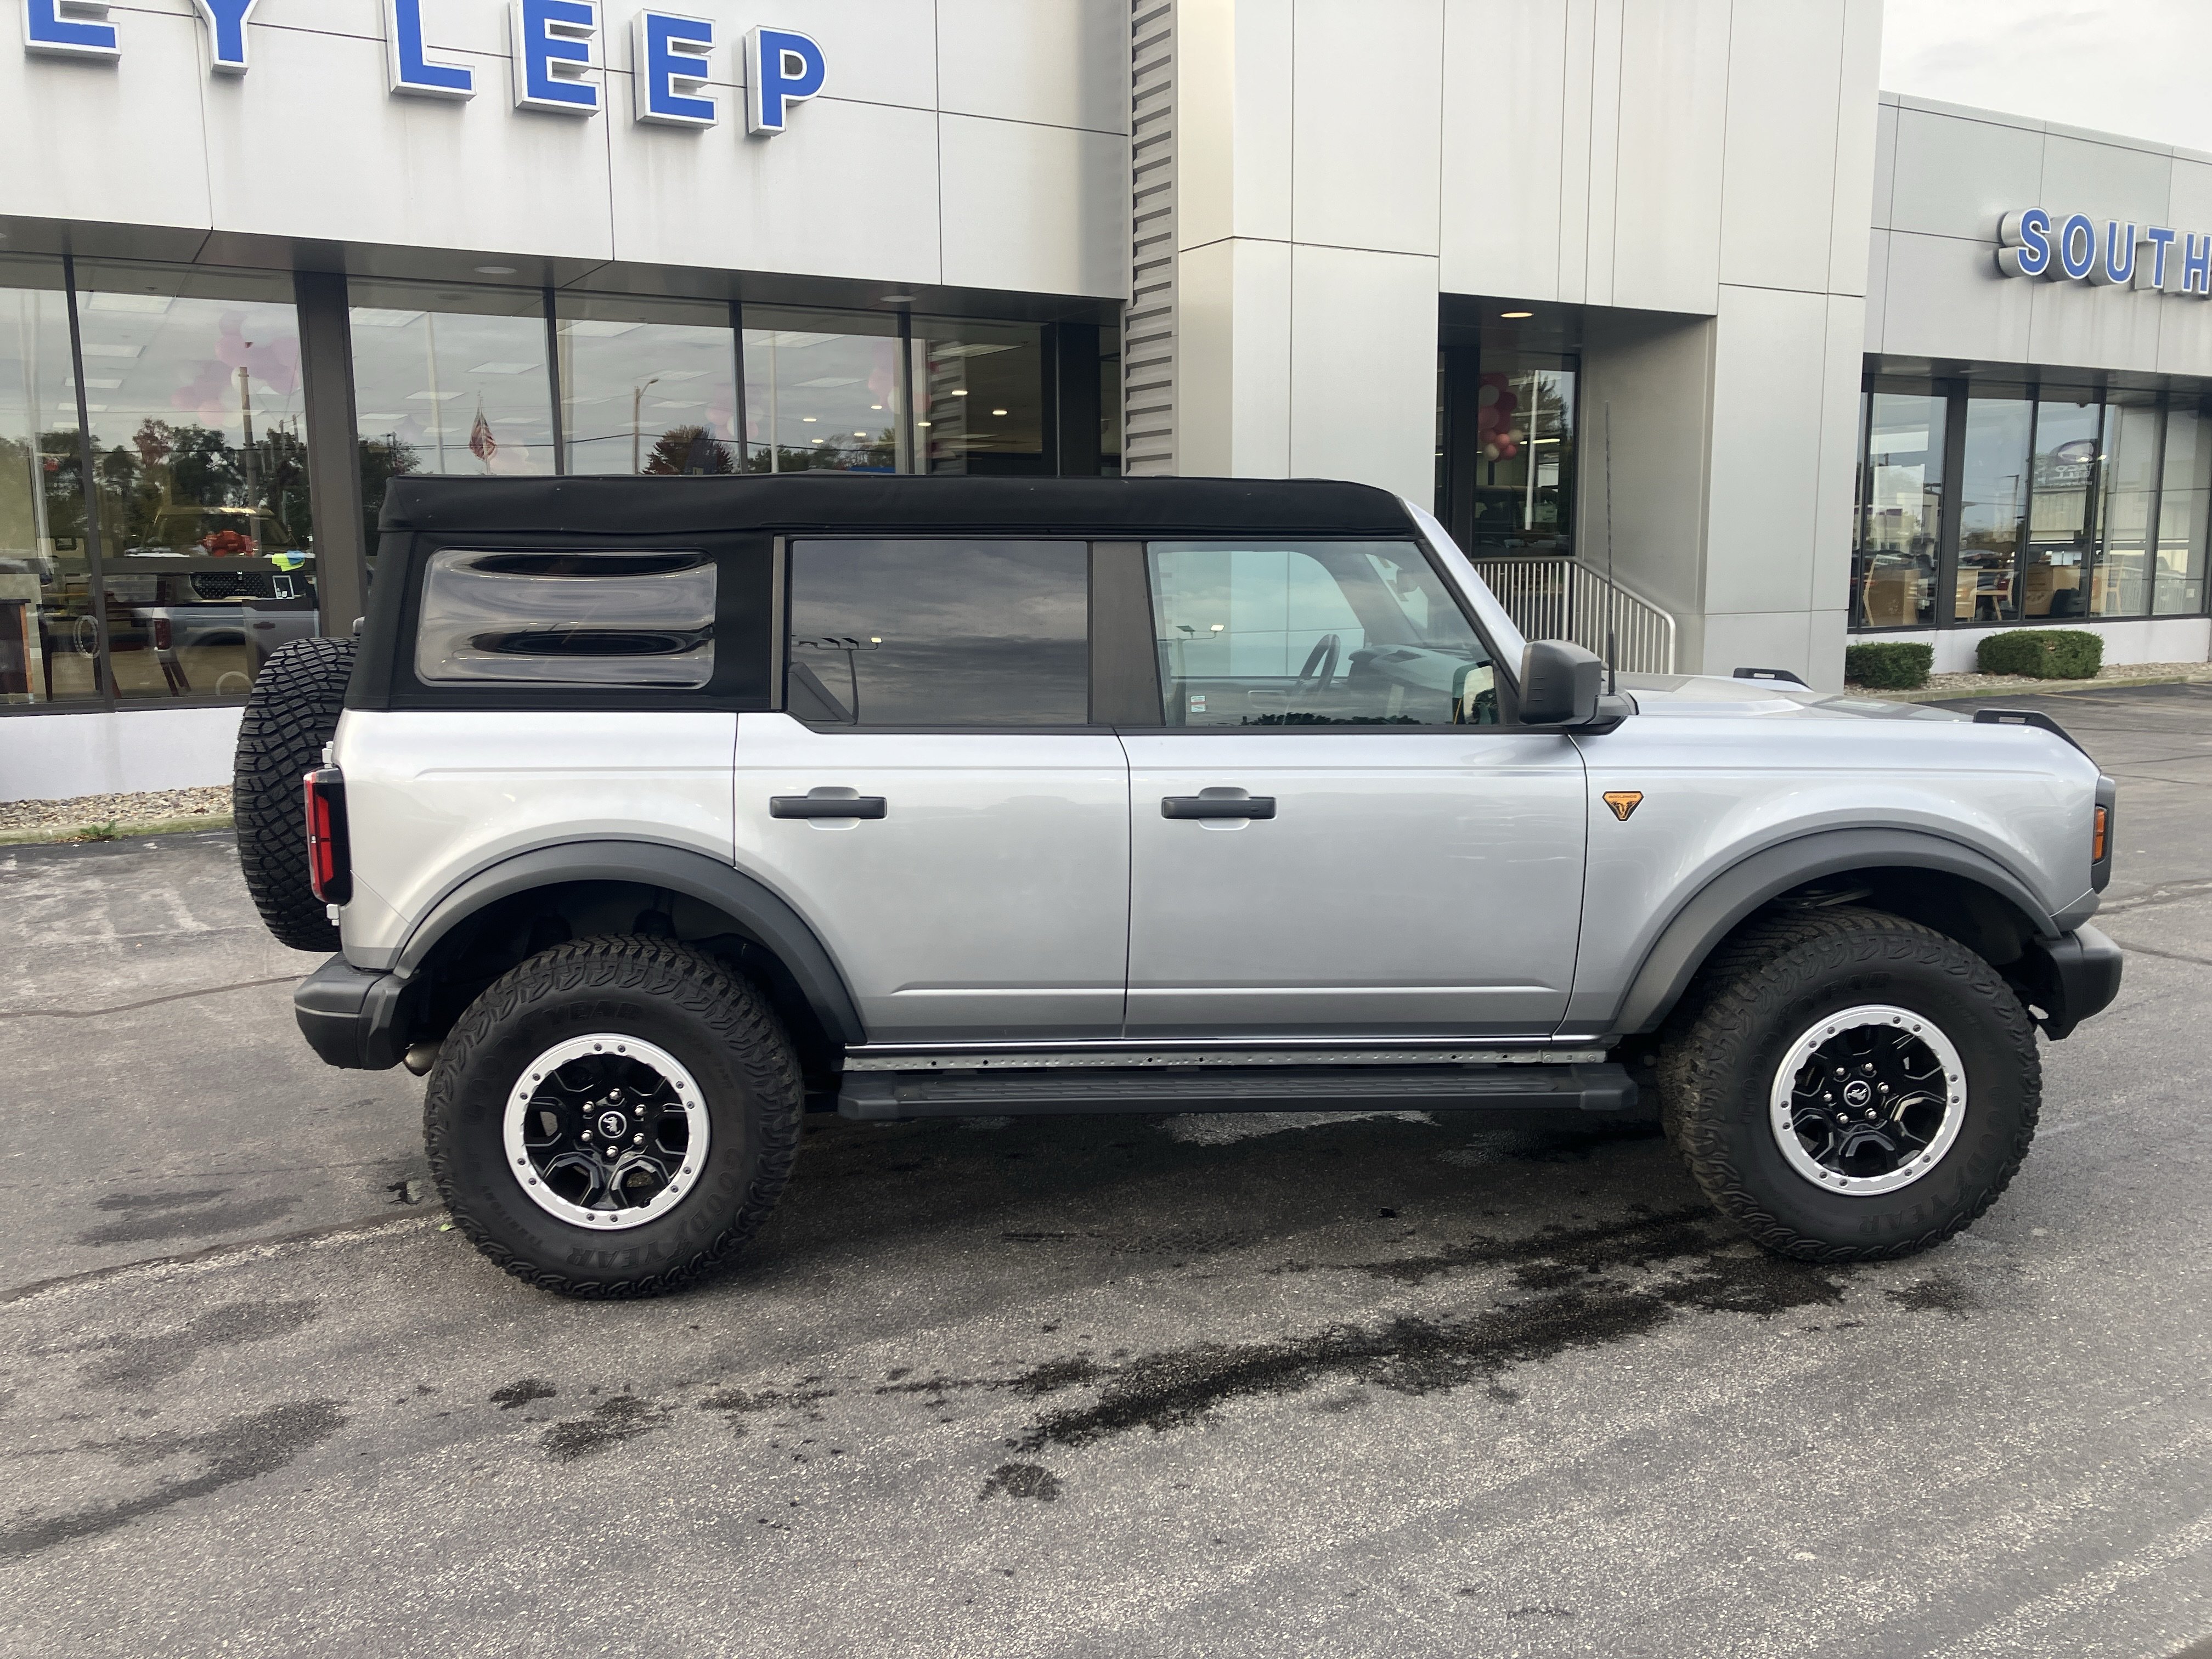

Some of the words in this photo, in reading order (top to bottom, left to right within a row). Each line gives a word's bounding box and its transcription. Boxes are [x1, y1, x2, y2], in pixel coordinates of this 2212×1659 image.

[386, 0, 828, 136] LEEP
[2011, 207, 2211, 295] SOUTH
[566, 1147, 743, 1271] GOODYEAR
